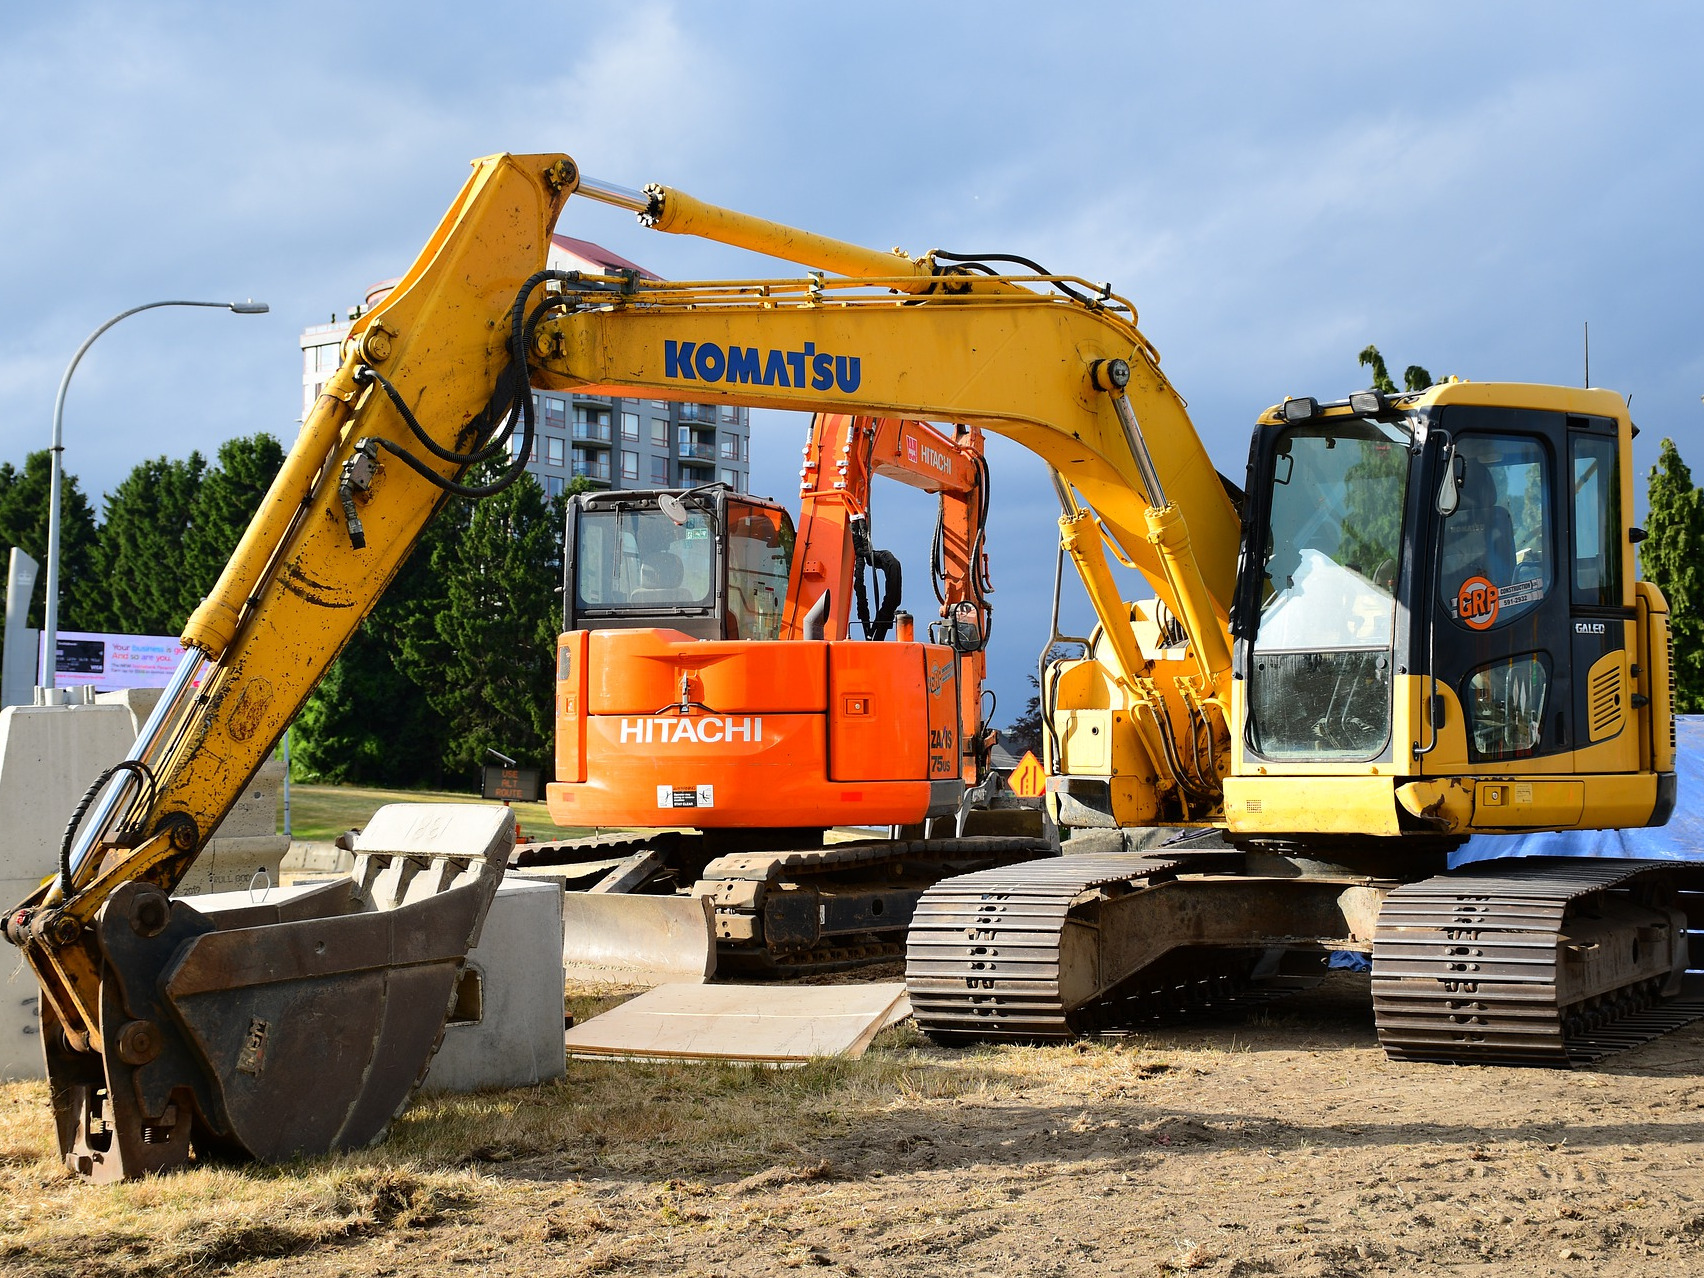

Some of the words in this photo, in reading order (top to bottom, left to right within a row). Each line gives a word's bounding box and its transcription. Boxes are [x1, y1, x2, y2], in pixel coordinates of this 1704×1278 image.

[664, 339, 861, 394] KOMATSU
[921, 444, 952, 475] HITACHI
[1500, 582, 1531, 595] CONSTRUCTION
[1460, 586, 1498, 618] GRP
[1503, 595, 1528, 606] 591-2932
[113, 643, 130, 651] Your
[112, 652, 129, 660] And
[619, 717, 762, 744] HITACHI
[502, 769, 518, 778] USE
[502, 779, 518, 788] ALT
[495, 788, 523, 798] ROUTE
